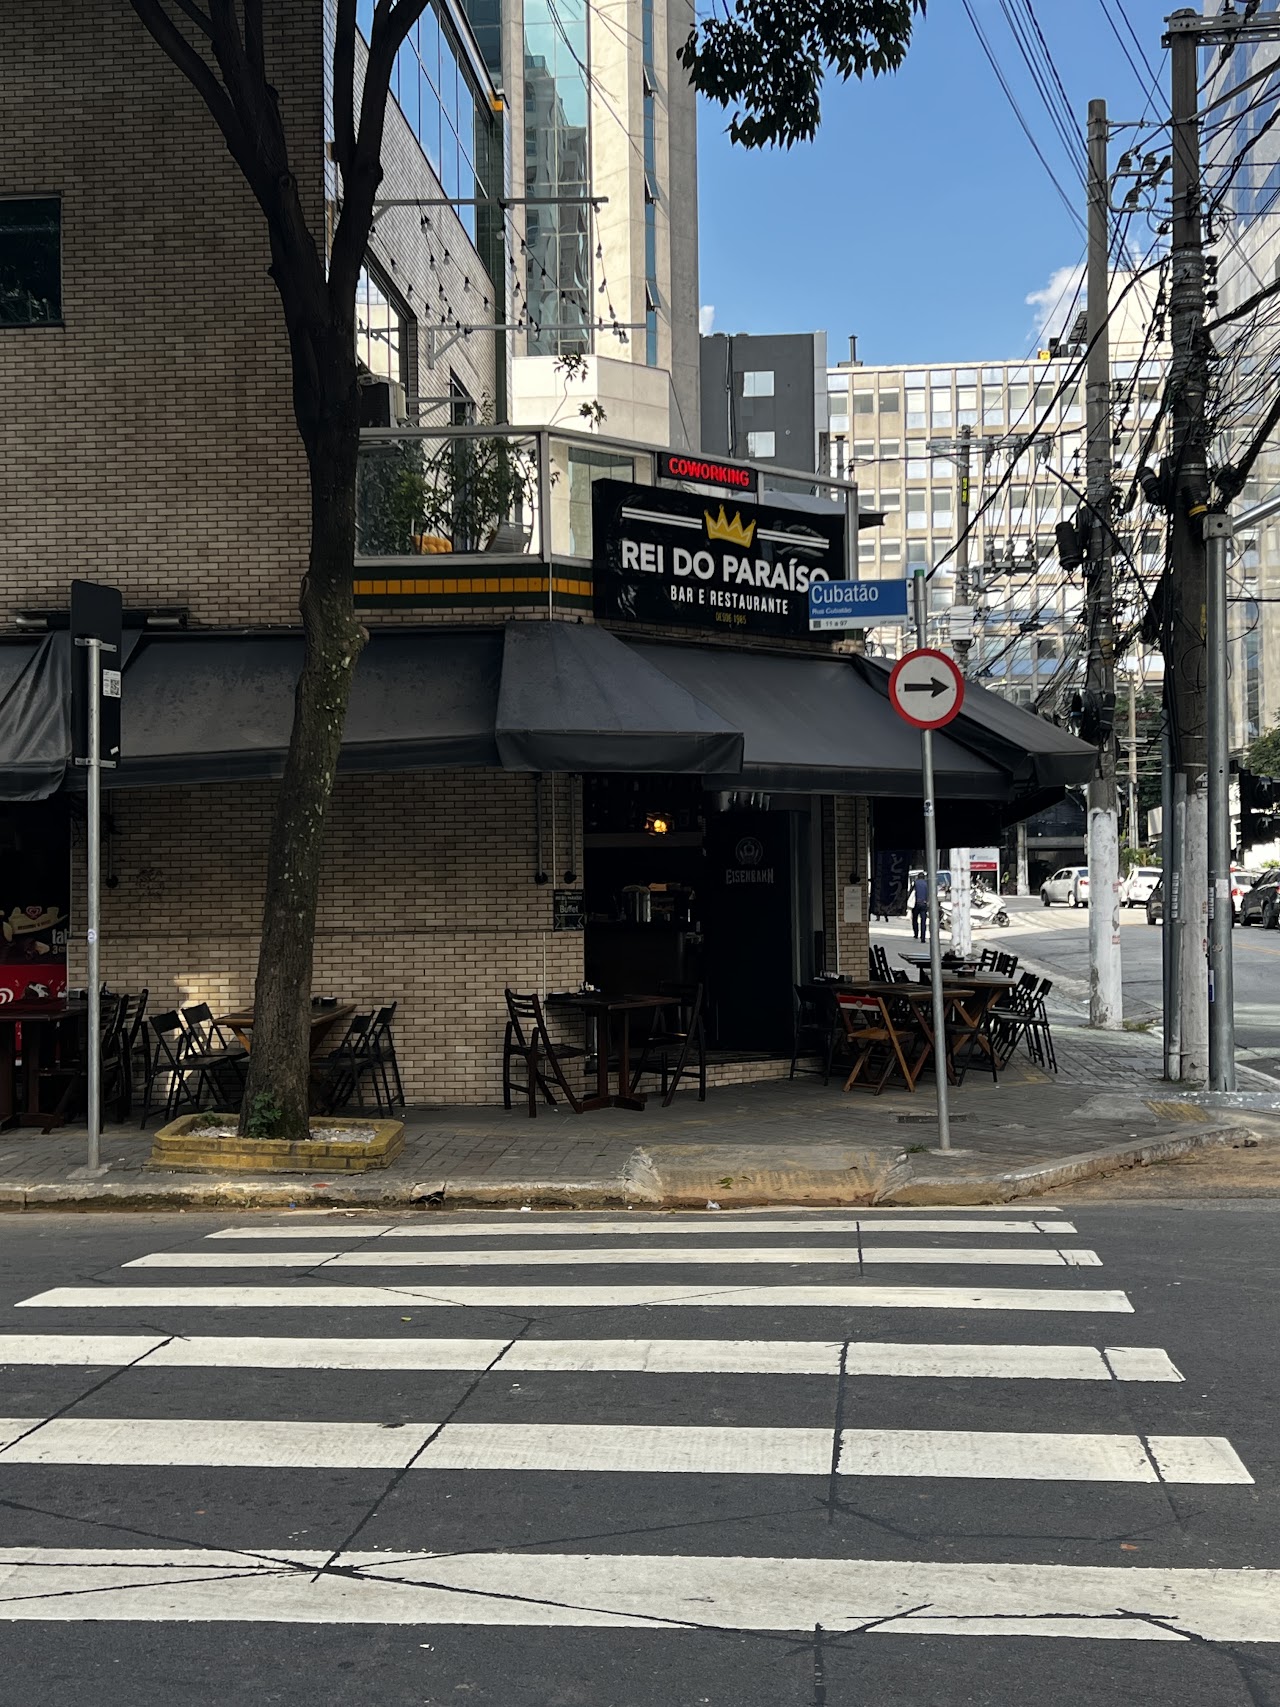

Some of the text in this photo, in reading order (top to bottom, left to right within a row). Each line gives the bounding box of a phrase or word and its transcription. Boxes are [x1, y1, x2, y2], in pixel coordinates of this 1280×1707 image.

[668, 457, 750, 486] COWORKING
[621, 540, 664, 574] REI
[673, 547, 715, 580] DO
[670, 585, 789, 616] BAR E RESTAURANTE
[811, 584, 879, 605] Cubatão
[715, 611, 733, 623] DESDE
[725, 867, 774, 885] EISENBAHN
